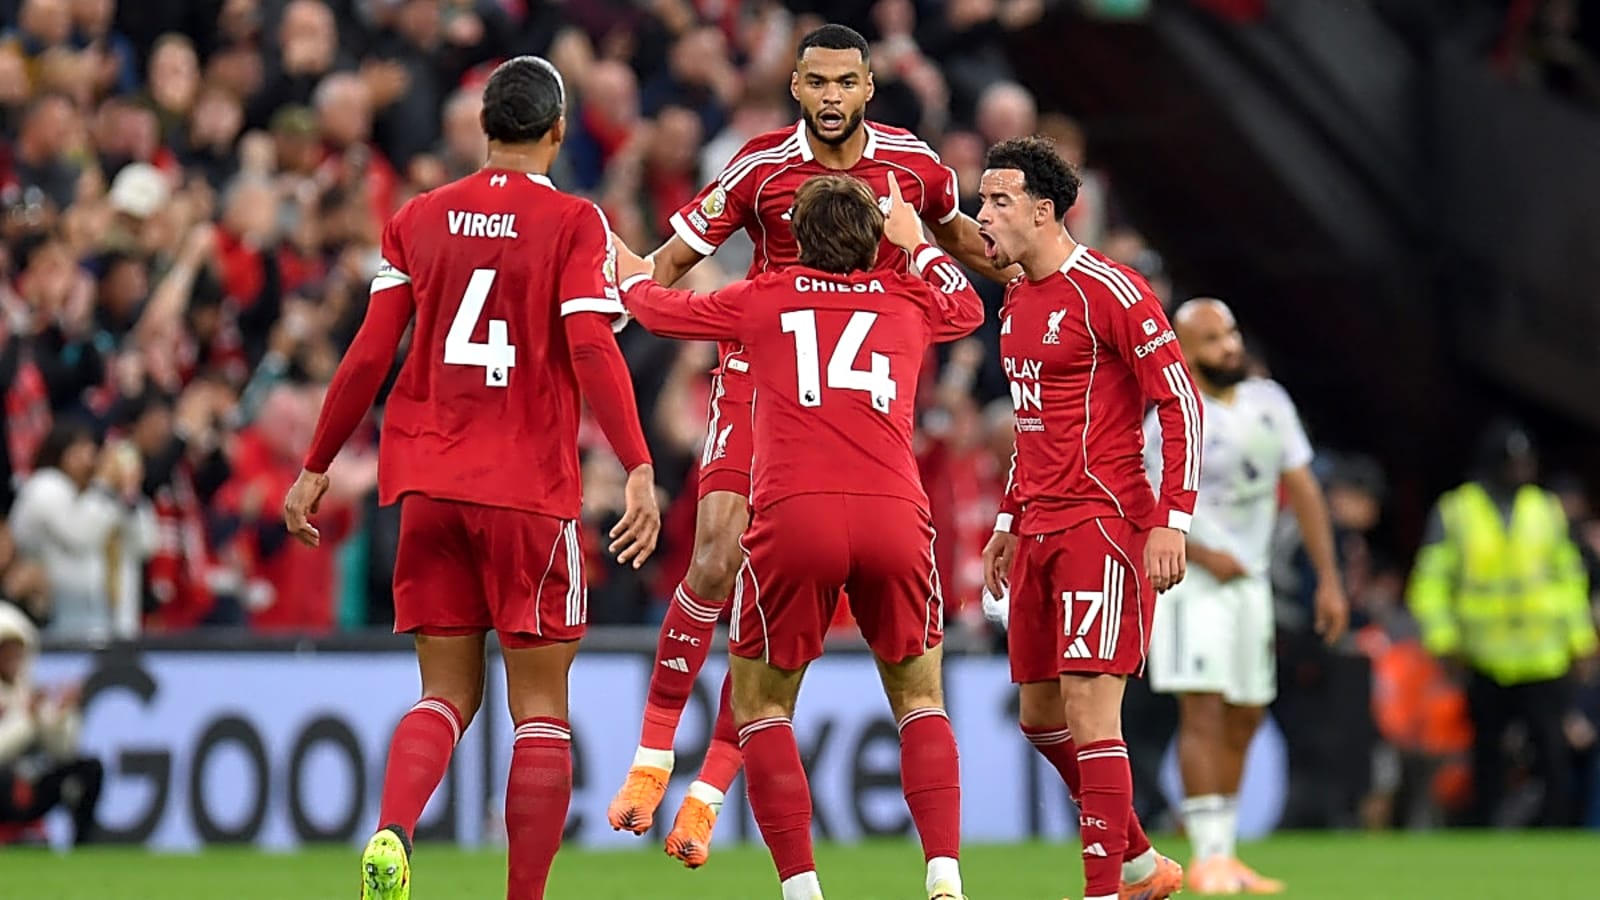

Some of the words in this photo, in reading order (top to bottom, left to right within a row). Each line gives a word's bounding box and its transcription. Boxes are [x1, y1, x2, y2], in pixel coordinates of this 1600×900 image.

[448, 210, 518, 239] VIRGIL
[795, 276, 885, 293] CHIESA
[444, 268, 516, 387] 4
[1134, 329, 1177, 359] Expedia
[780, 309, 896, 414] 14
[1004, 357, 1042, 380] PLAY
[1062, 591, 1104, 636] 17
[667, 628, 701, 647] LFC
[78, 648, 596, 846] Gool
[1079, 815, 1107, 830] LFC
